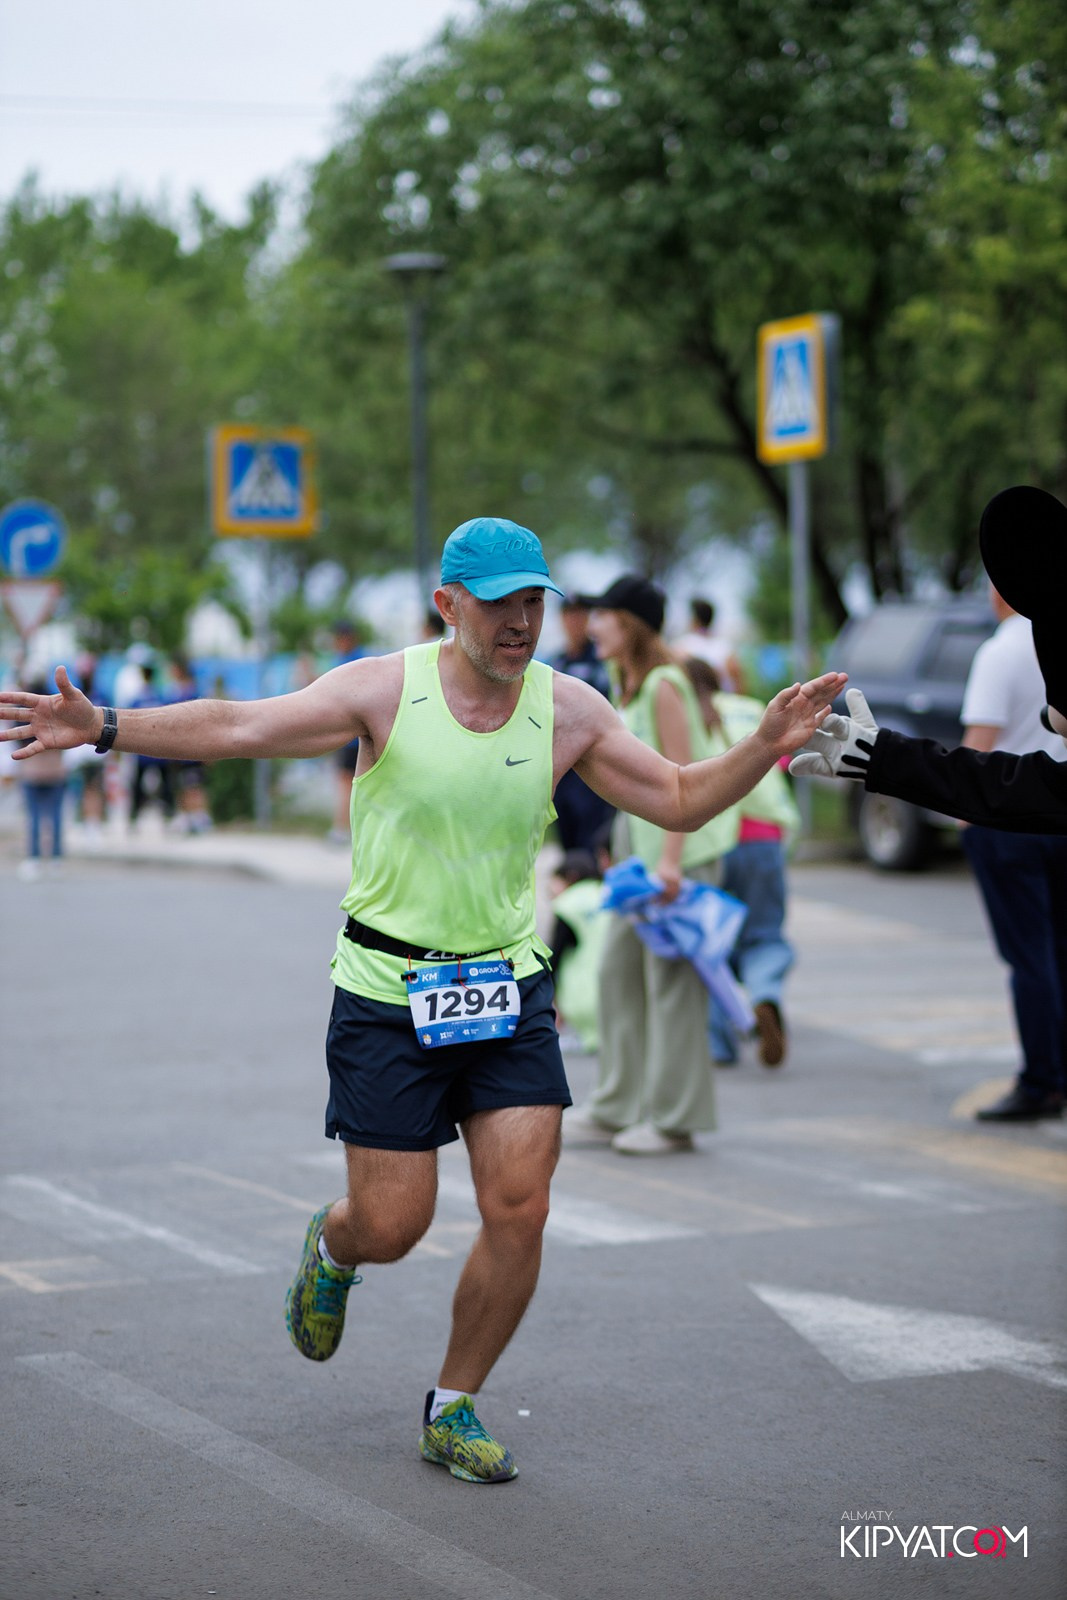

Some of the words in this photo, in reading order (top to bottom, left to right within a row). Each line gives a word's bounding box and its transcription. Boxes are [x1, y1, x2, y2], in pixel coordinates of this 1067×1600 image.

[479, 967, 500, 976] GROUP
[421, 972, 438, 982] KM
[425, 985, 510, 1021] 1294
